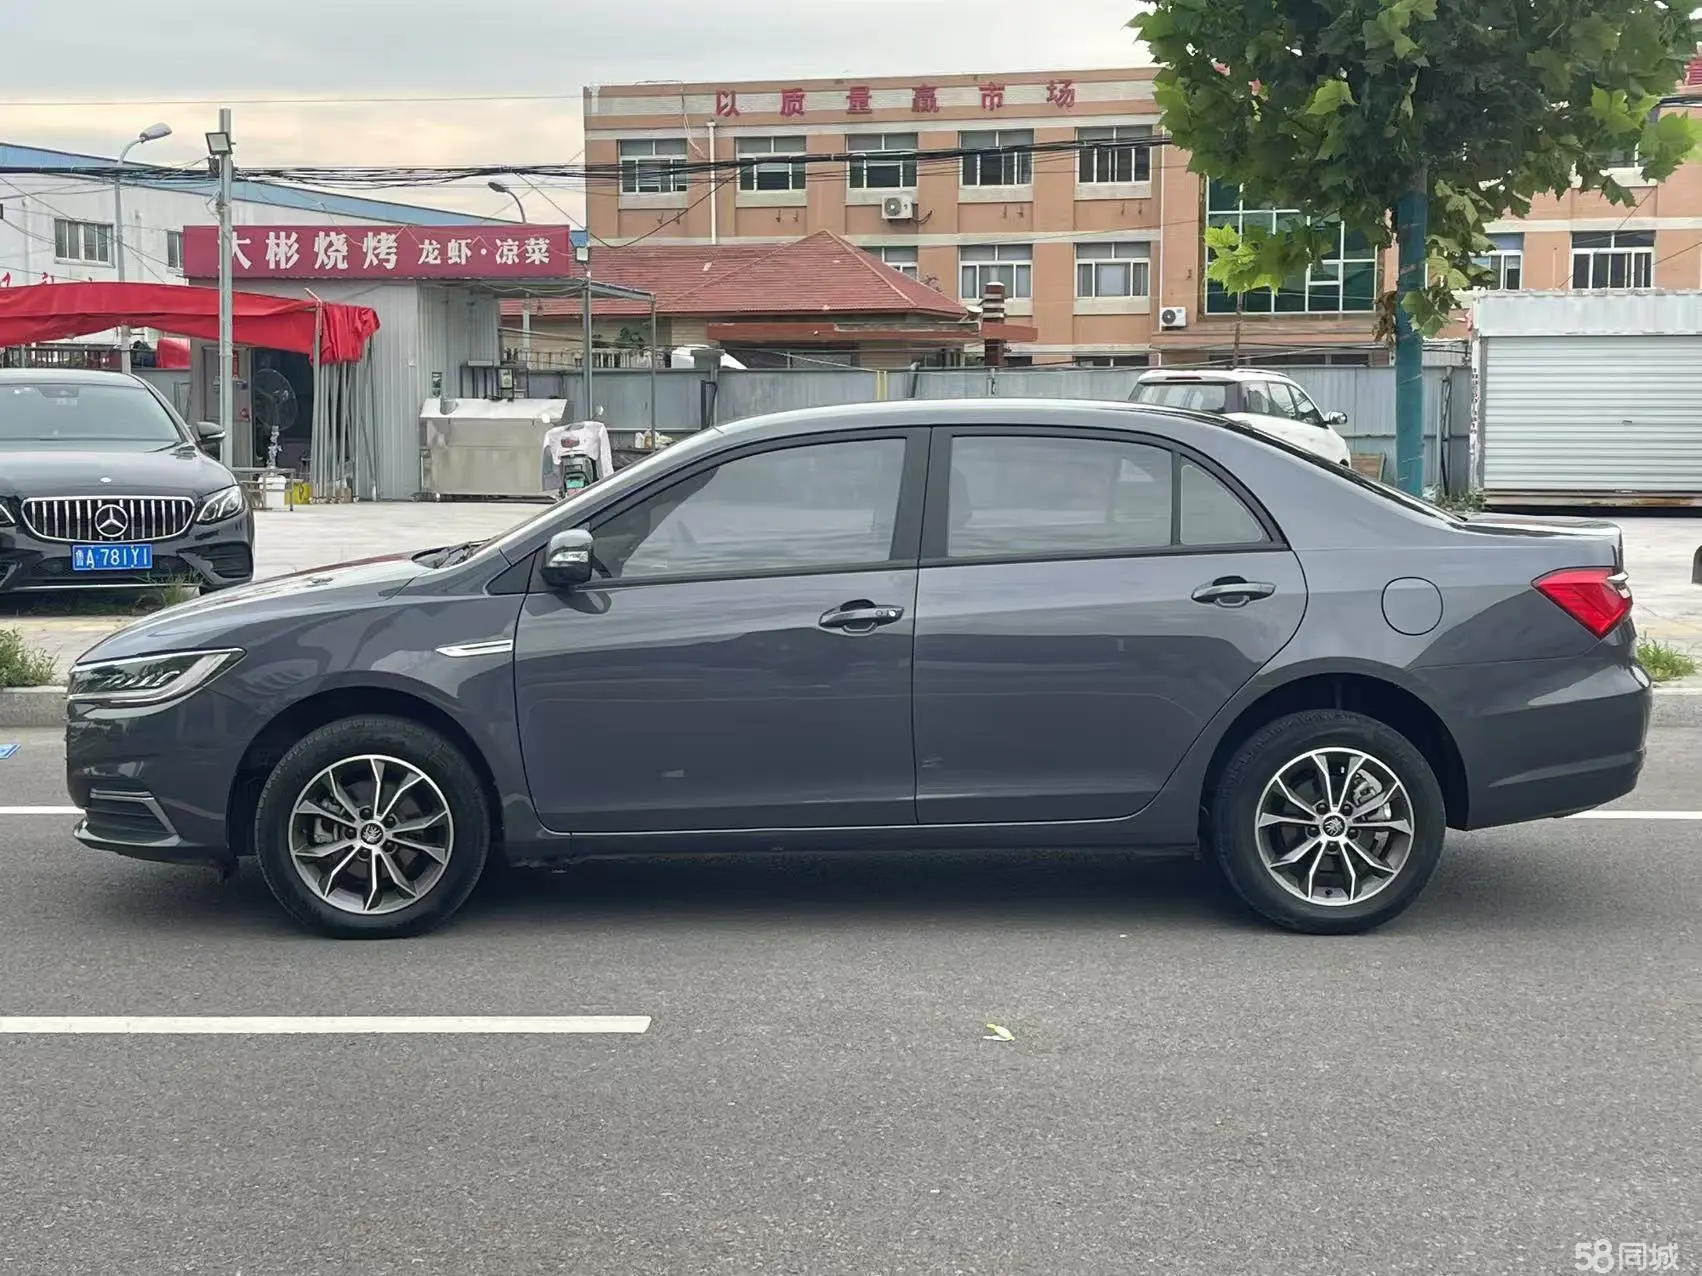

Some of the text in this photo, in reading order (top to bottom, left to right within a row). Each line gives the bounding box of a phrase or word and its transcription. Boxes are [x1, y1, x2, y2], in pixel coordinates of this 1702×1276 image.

[715, 79, 1077, 117] 以质量赢市场
